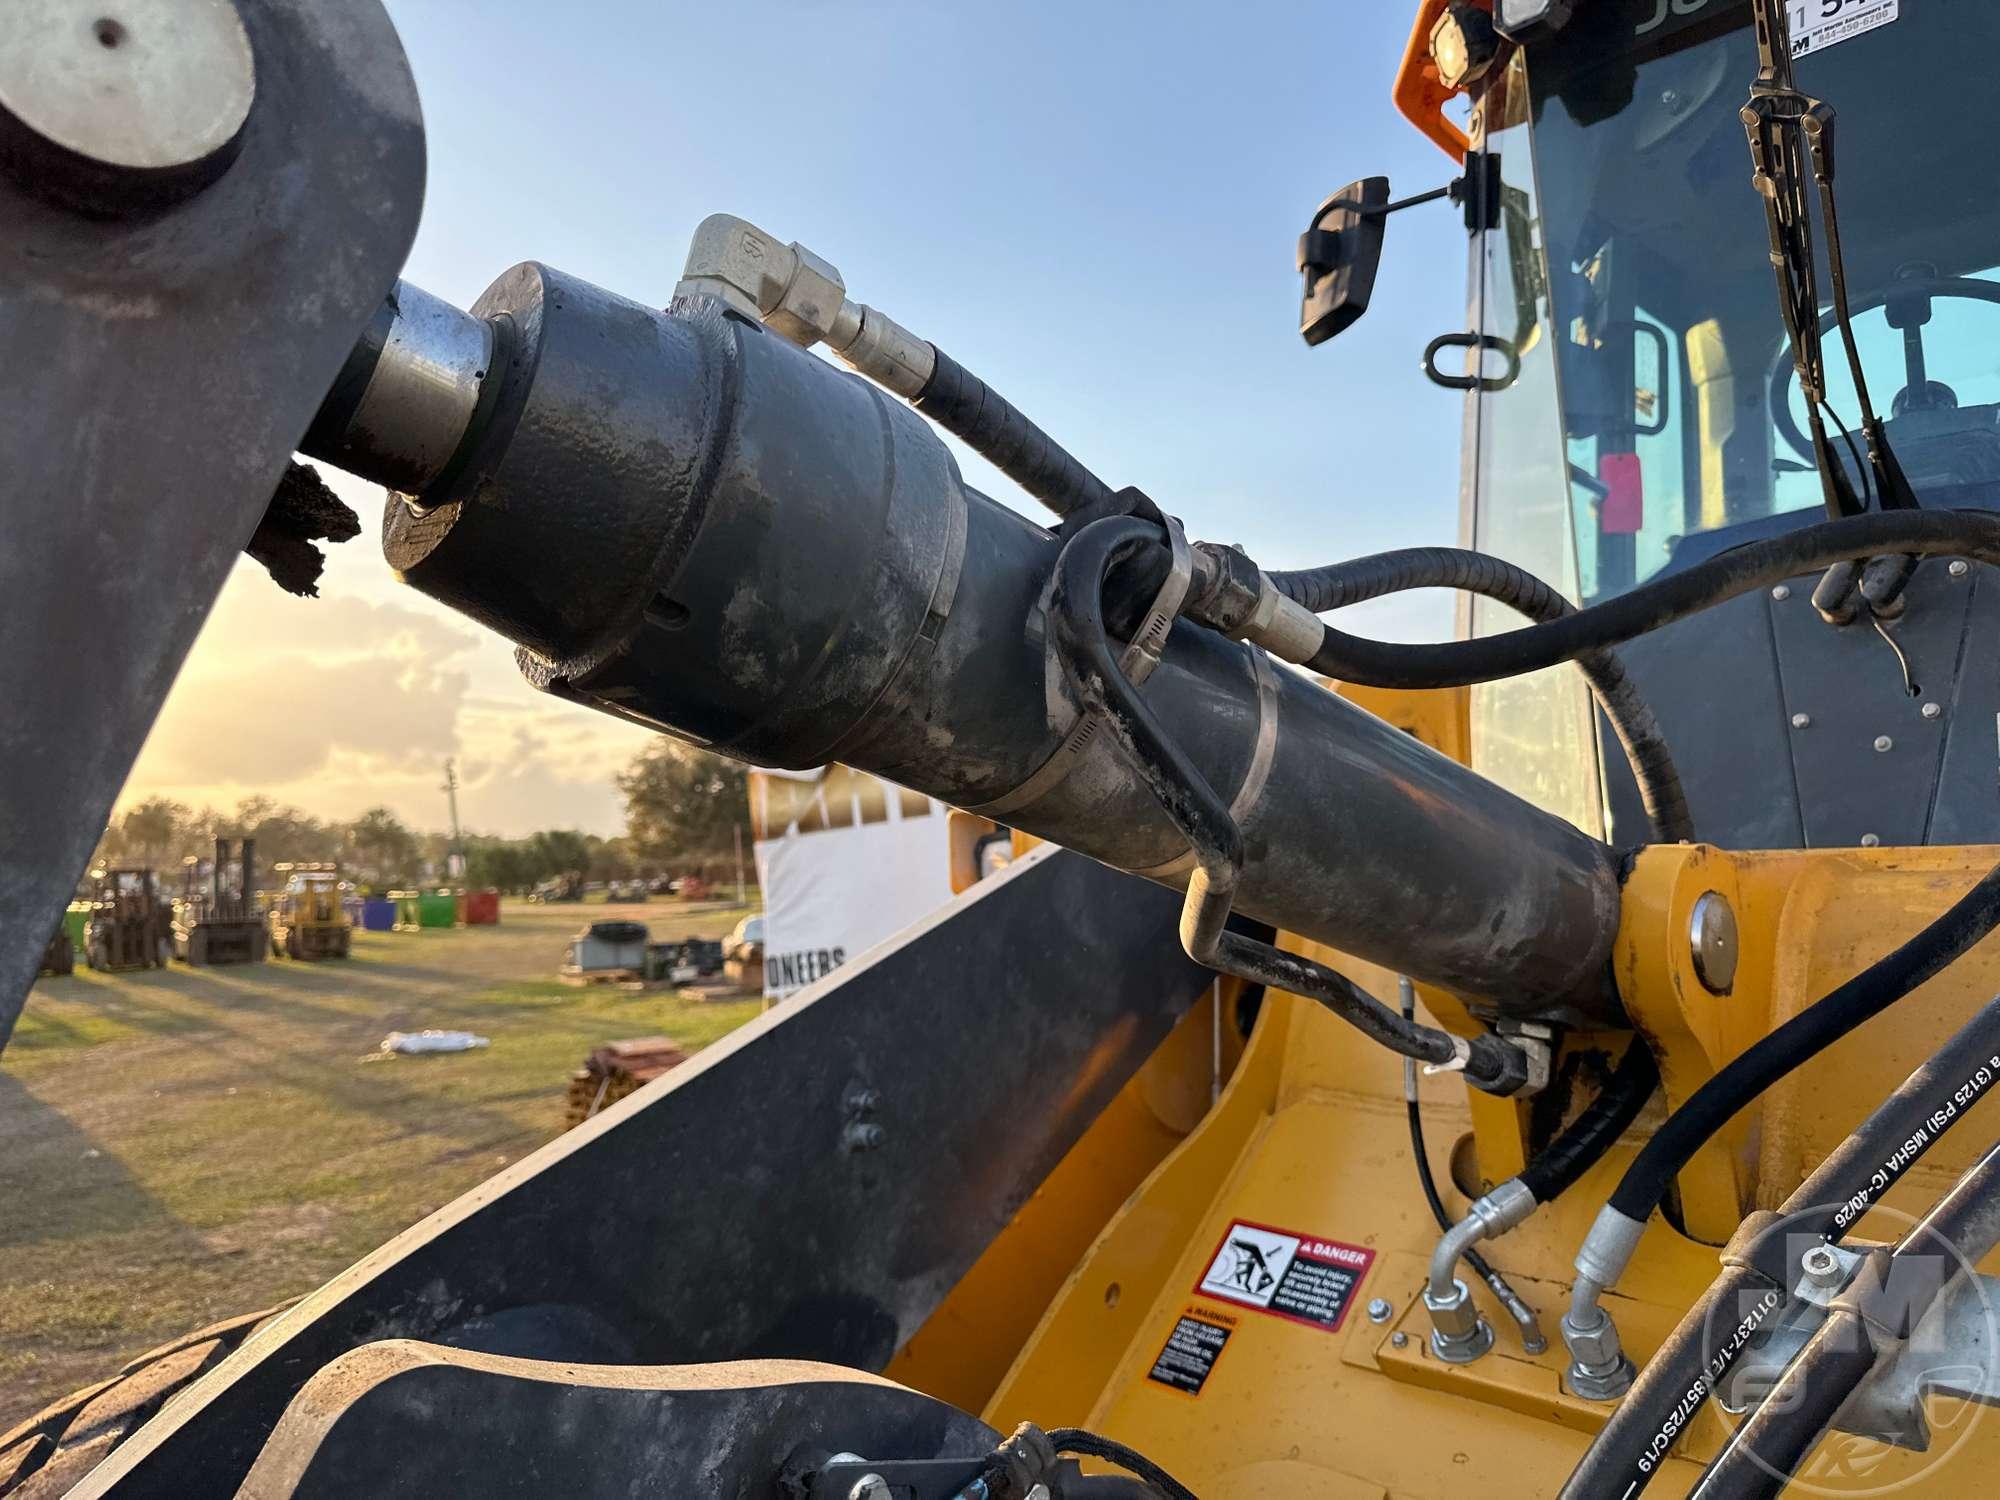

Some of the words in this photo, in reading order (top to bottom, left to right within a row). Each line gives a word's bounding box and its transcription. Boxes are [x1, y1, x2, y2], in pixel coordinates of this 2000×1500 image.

[1954, 1067, 1992, 1106] (3125
[1926, 1101, 1957, 1134] PSI)
[1885, 1128, 1930, 1173] MSHA
[1834, 1174, 1889, 1228] IC-40/26
[1313, 1242, 1366, 1266] DANGER
[1288, 1271, 1321, 1286] securely
[1293, 1260, 1305, 1270] To
[1304, 1264, 1327, 1277] avoid
[1279, 1287, 1329, 1306] disassembly
[1329, 1299, 1341, 1309] of
[1283, 1278, 1295, 1288] lift
[1295, 1281, 1312, 1292] arm
[1312, 1285, 1339, 1299] before
[1194, 1307, 1237, 1326] WARNING
[1296, 1301, 1307, 1310] or
